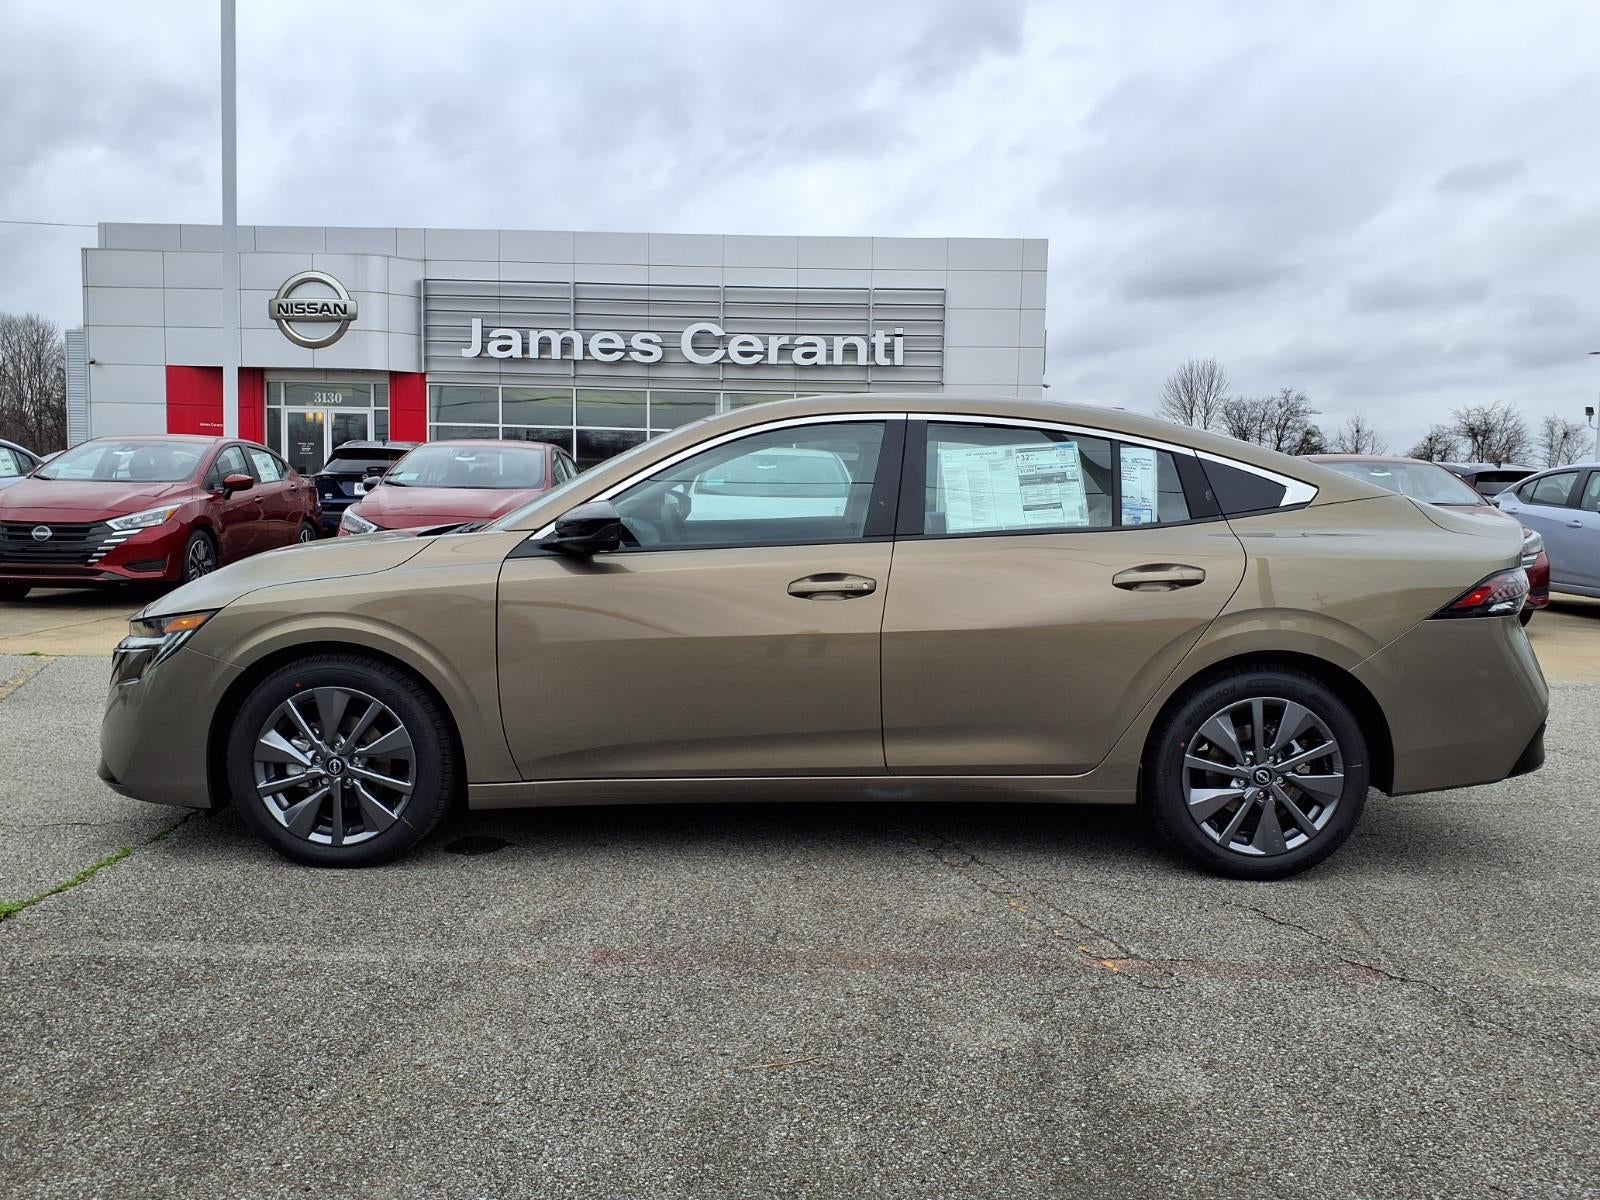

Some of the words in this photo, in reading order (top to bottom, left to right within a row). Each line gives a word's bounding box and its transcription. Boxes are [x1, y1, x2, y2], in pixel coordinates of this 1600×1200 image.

[277, 303, 347, 315] NISSAN
[461, 318, 663, 363] James
[680, 322, 904, 366] Ceranti
[313, 391, 343, 404] 3130
